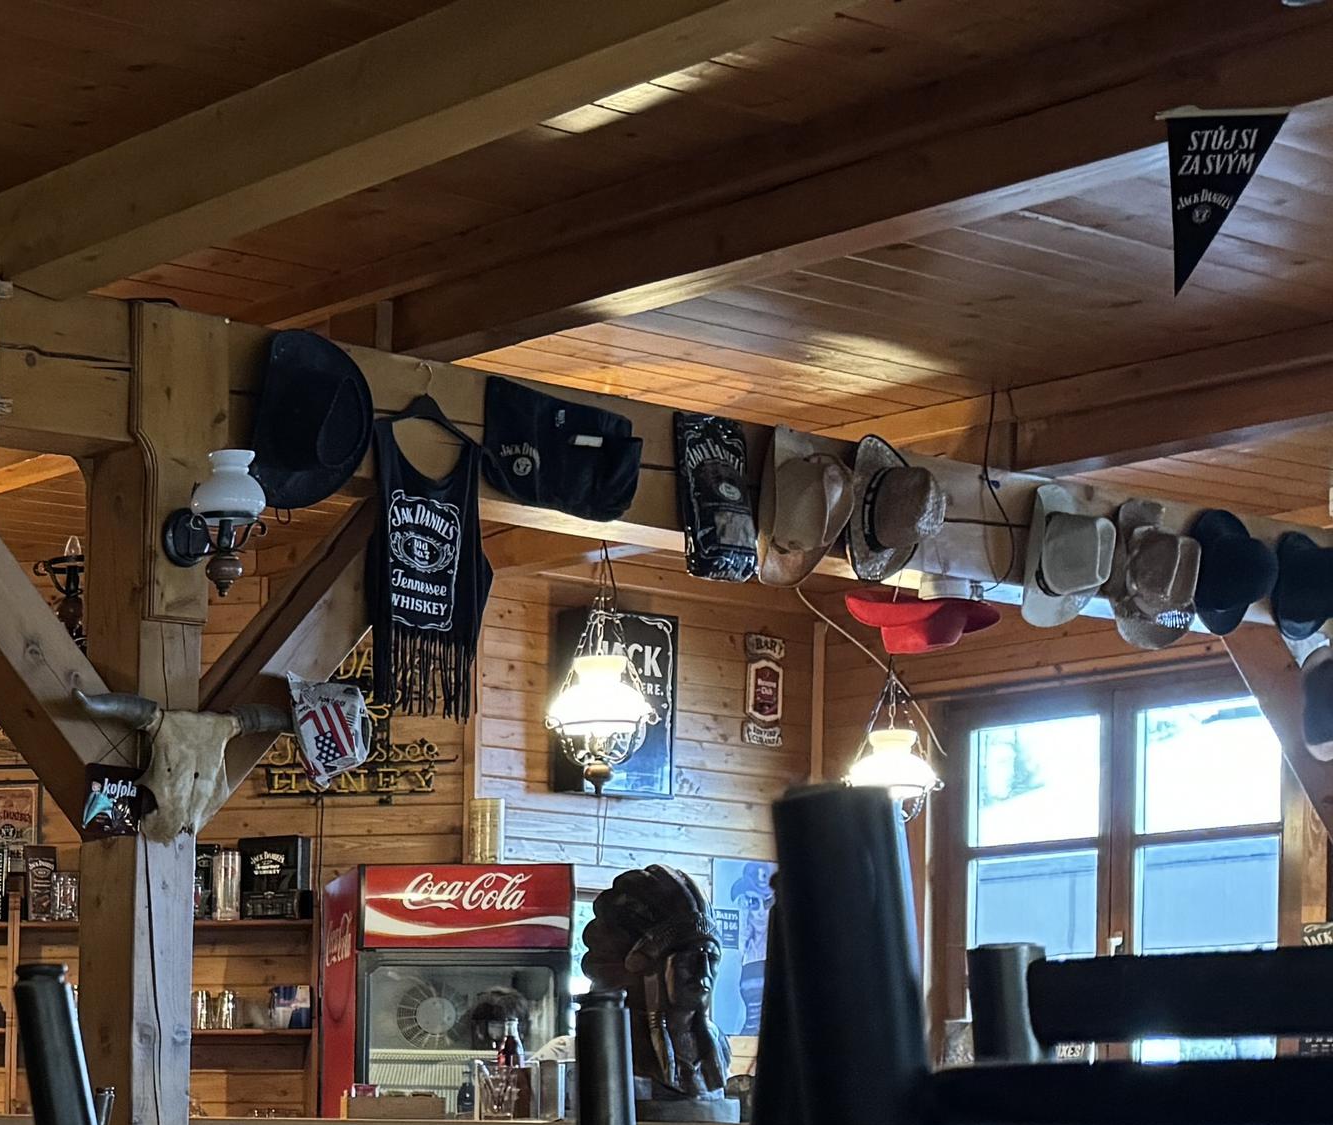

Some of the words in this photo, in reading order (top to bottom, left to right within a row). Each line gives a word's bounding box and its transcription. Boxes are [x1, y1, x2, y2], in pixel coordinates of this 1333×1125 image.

[1237, 128, 1259, 151] SI
[1178, 154, 1200, 176] ZA
[1202, 149, 1256, 176] SVÝM
[391, 504, 414, 527] JAK
[414, 503, 458, 541] DANIEL'S
[391, 568, 448, 597] Tennessee
[602, 639, 663, 679] CK
[102, 777, 138, 799] kofola
[401, 871, 534, 912] Coca-Cola
